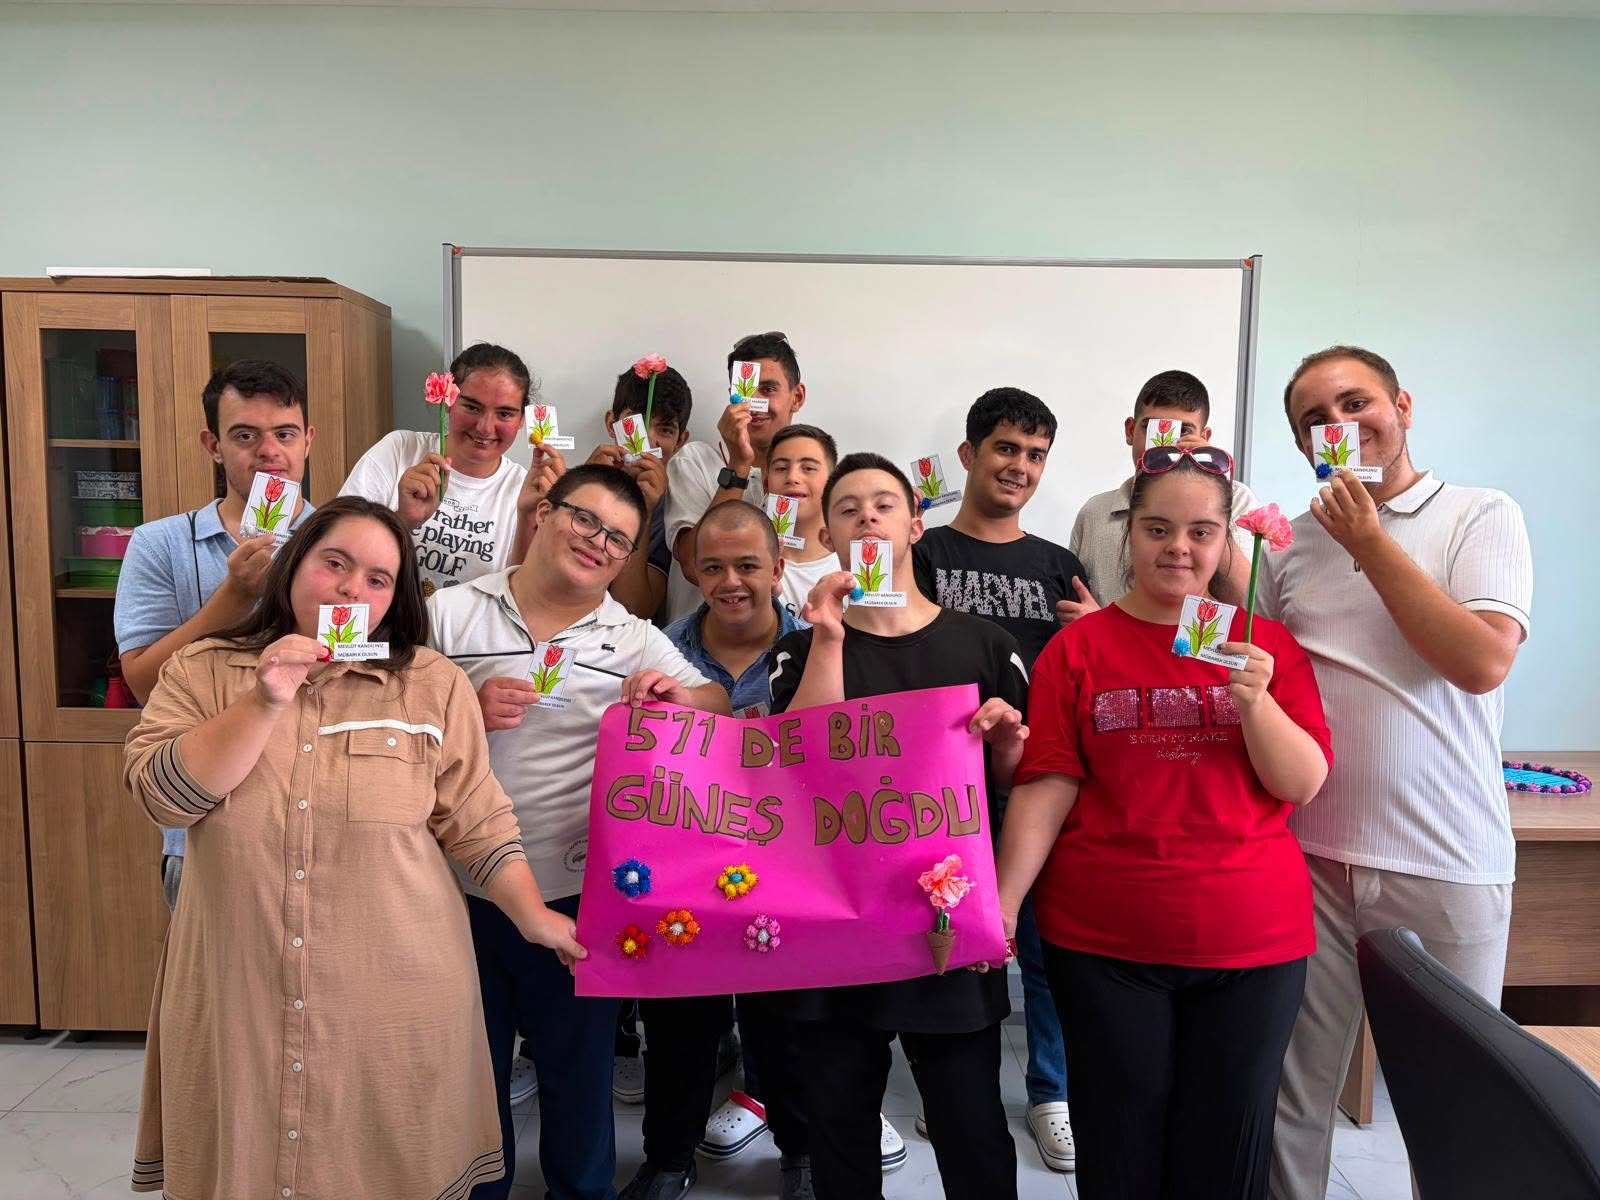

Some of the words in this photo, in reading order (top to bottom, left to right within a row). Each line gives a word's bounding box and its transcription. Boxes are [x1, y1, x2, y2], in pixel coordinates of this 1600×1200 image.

[432, 509, 494, 534] rather
[415, 545, 467, 577] GOLF
[420, 526, 494, 562] playing
[936, 568, 1054, 622] MARVEL
[1222, 659, 1238, 667] OLSUN
[625, 705, 716, 757] 571
[741, 717, 805, 768] DE
[828, 703, 901, 760] BİR
[1169, 734, 1186, 743] TO
[1188, 731, 1229, 743] MAKE
[606, 765, 784, 846] GÜNEŞ
